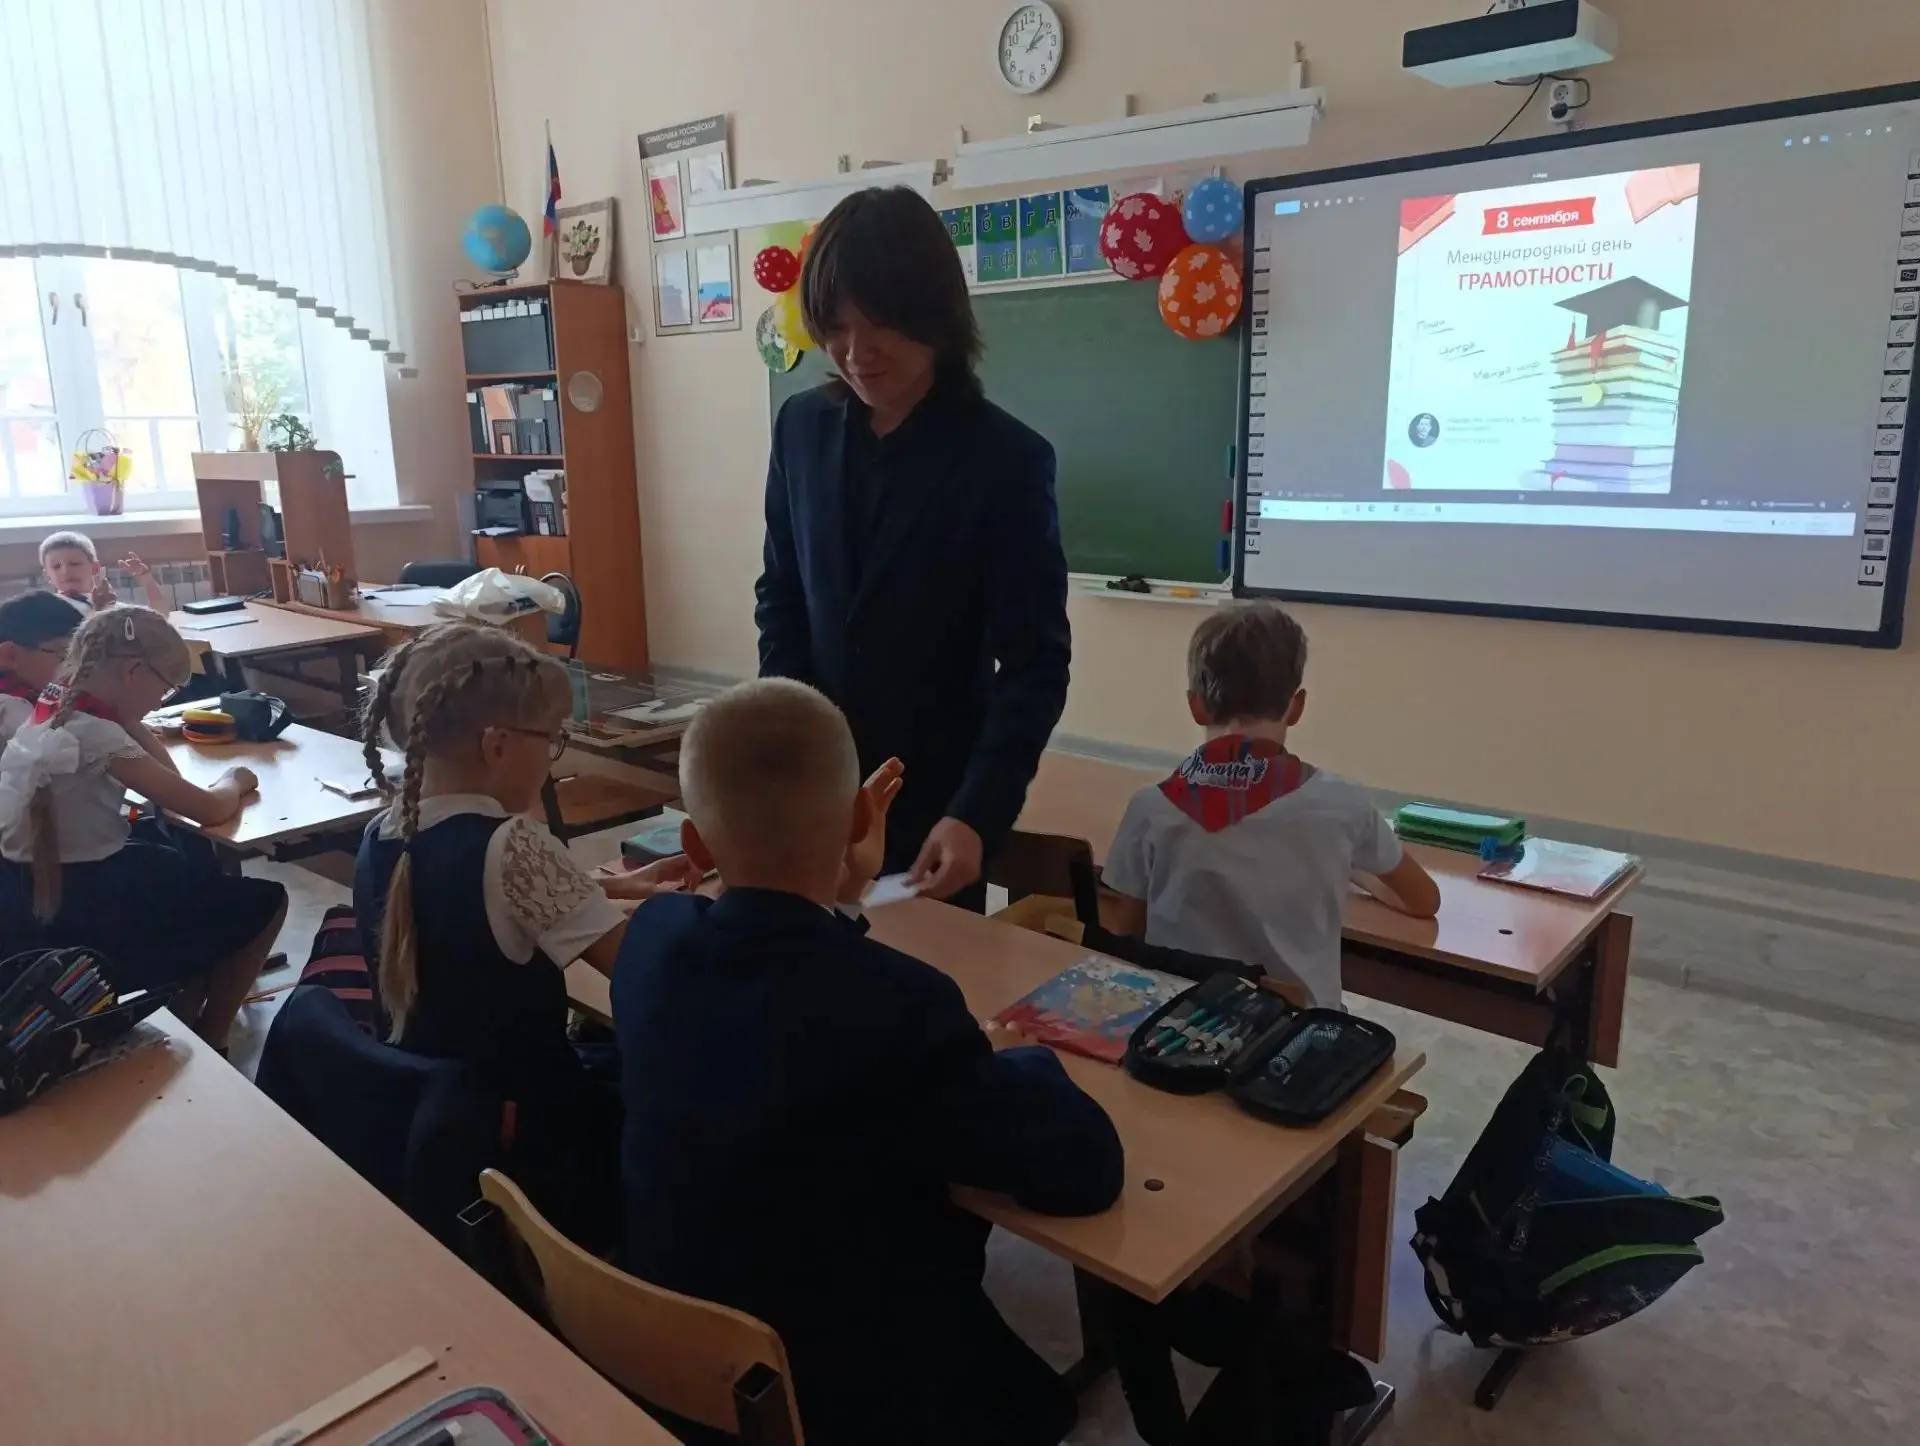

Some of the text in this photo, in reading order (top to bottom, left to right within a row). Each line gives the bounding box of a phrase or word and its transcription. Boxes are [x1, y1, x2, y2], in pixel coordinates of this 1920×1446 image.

[1008, 33, 1019, 47] 10
[1051, 34, 1057, 47] 3
[1497, 208, 1580, 229] 8 сентября
[1447, 238, 1632, 265] Международный день
[1457, 262, 1614, 290] ГРАМОТНОСТИ
